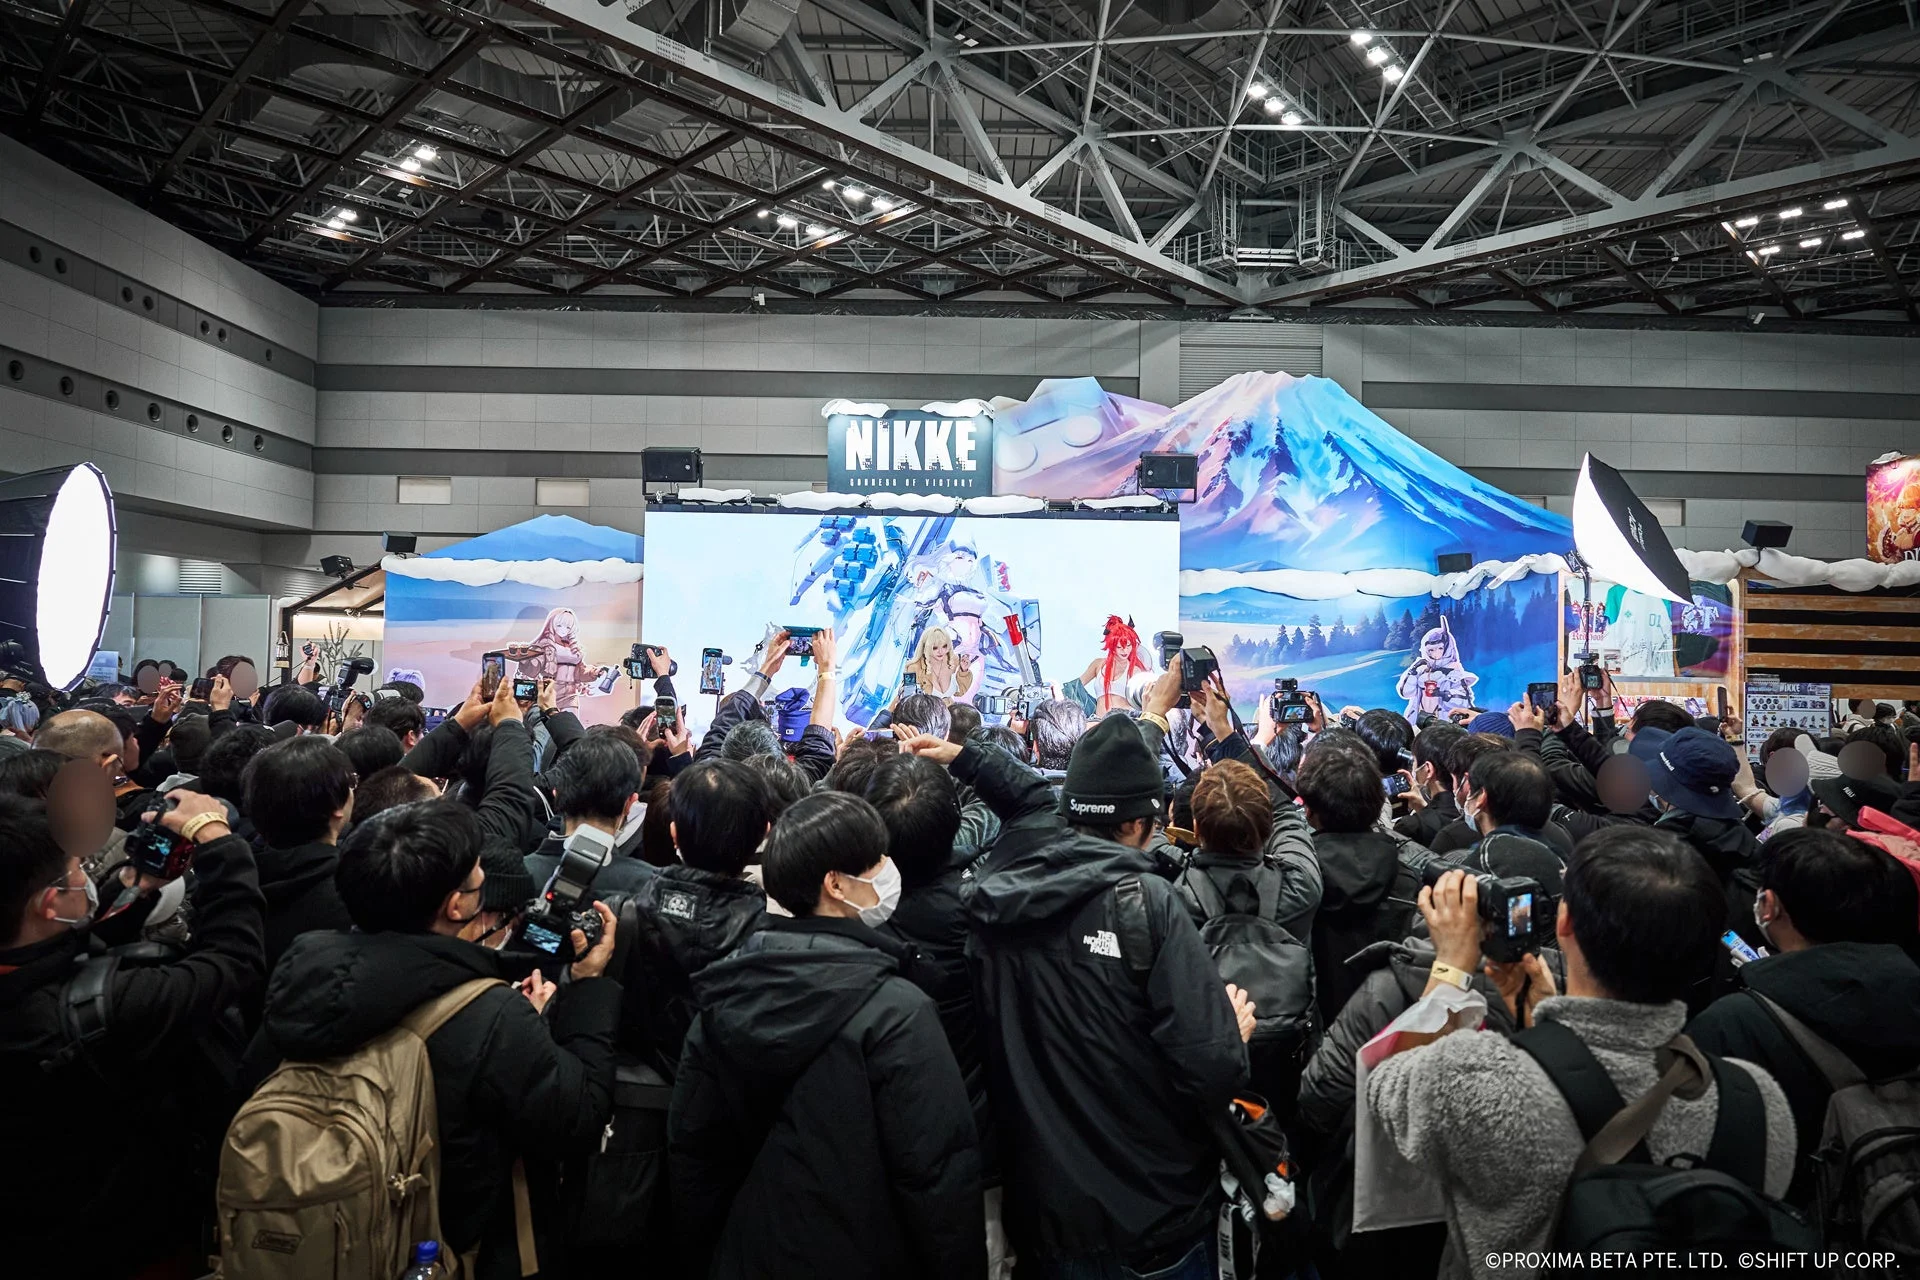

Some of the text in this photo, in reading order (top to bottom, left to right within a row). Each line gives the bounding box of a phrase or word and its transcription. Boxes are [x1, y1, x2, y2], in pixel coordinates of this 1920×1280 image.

[845, 420, 976, 471] NIKKE
[850, 478, 974, 488] GODDESS OF VICTORY
[1070, 798, 1115, 815] Supreme
